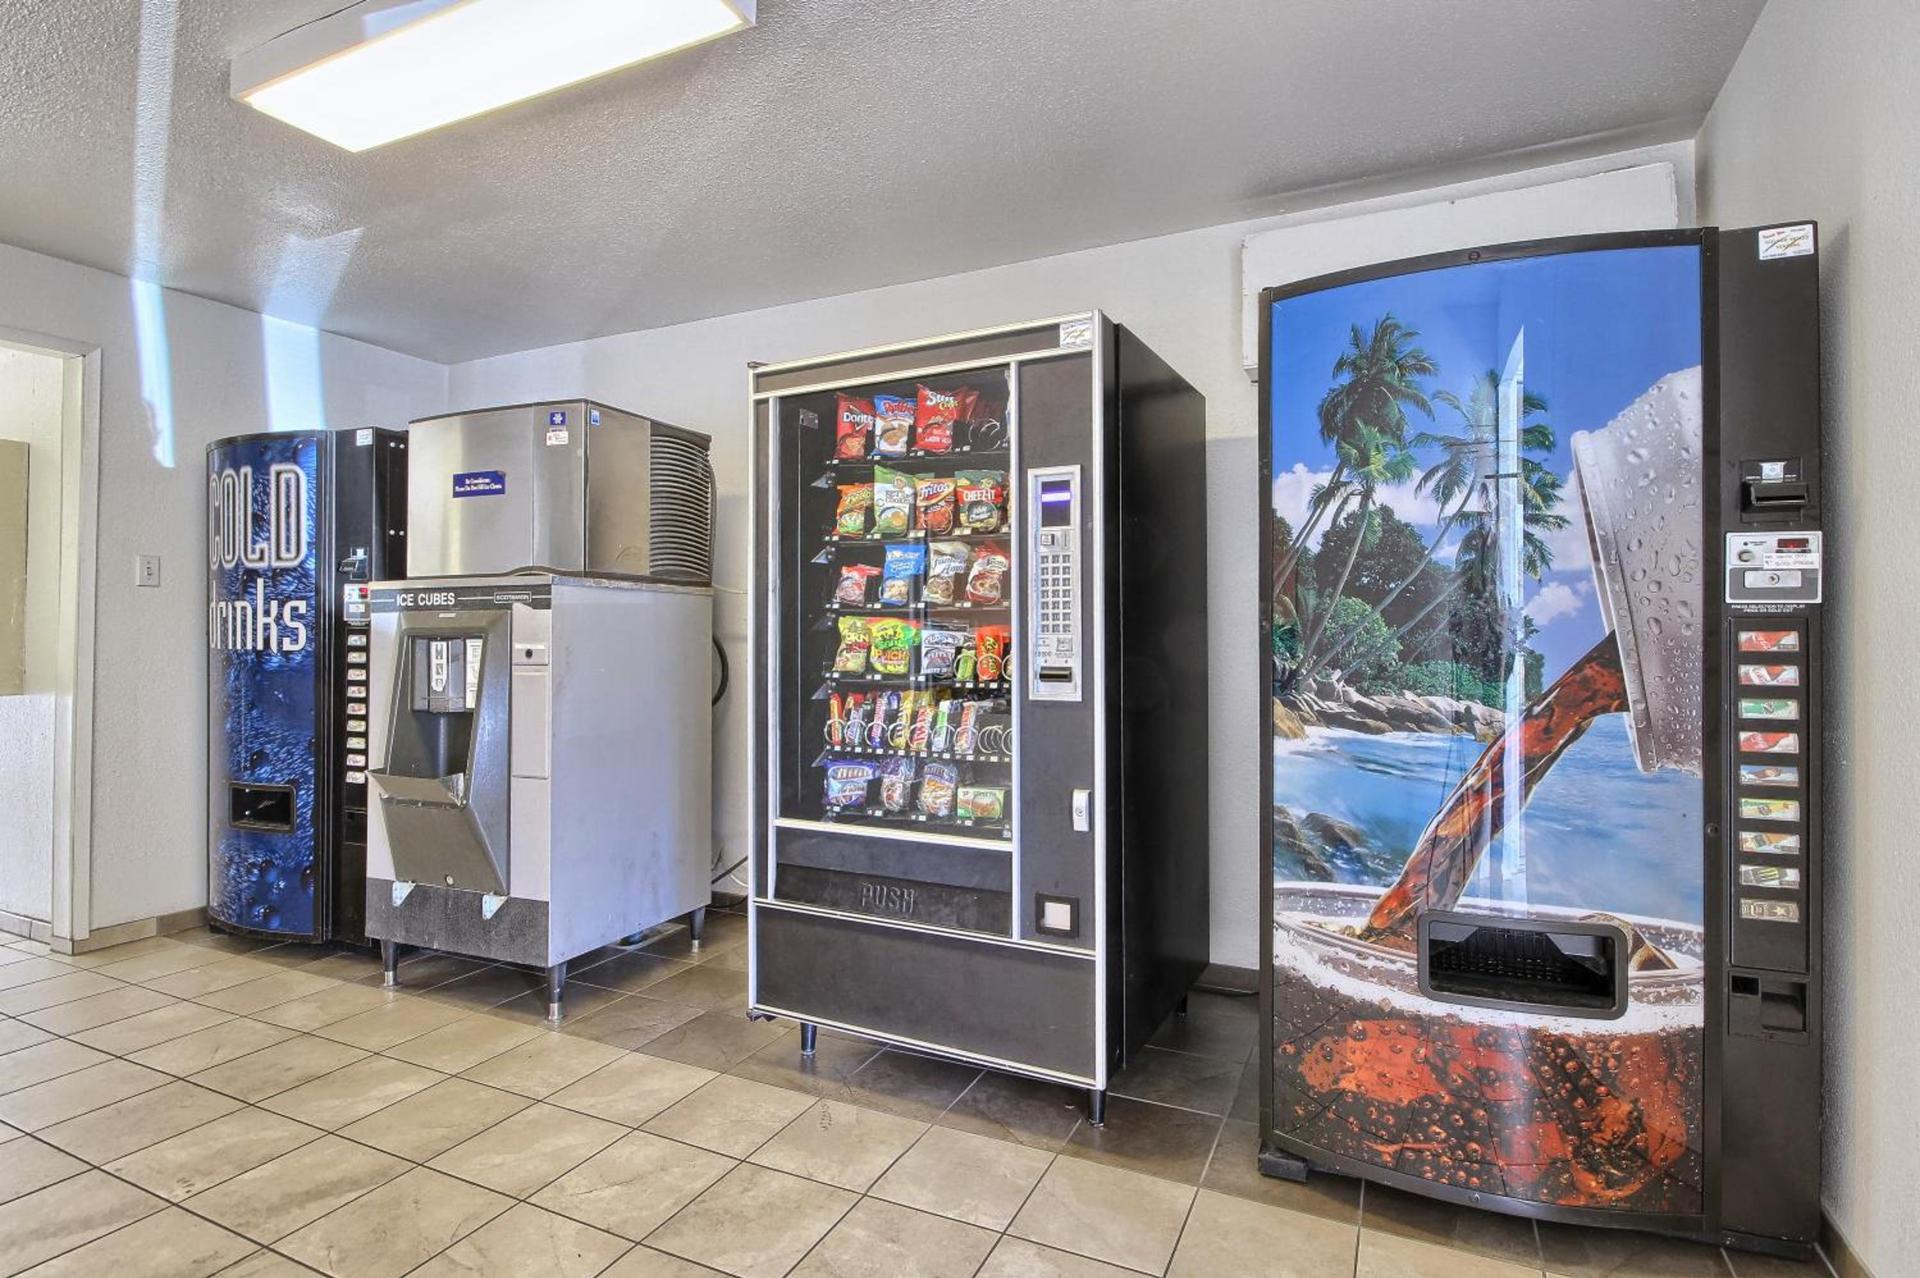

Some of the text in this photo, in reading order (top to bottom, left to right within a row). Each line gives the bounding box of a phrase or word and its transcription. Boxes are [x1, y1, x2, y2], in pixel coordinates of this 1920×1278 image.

[209, 463, 308, 570] COLD
[209, 578, 307, 654] drinks
[397, 593, 455, 606] ICE CUBES
[861, 882, 915, 914] PUSH
